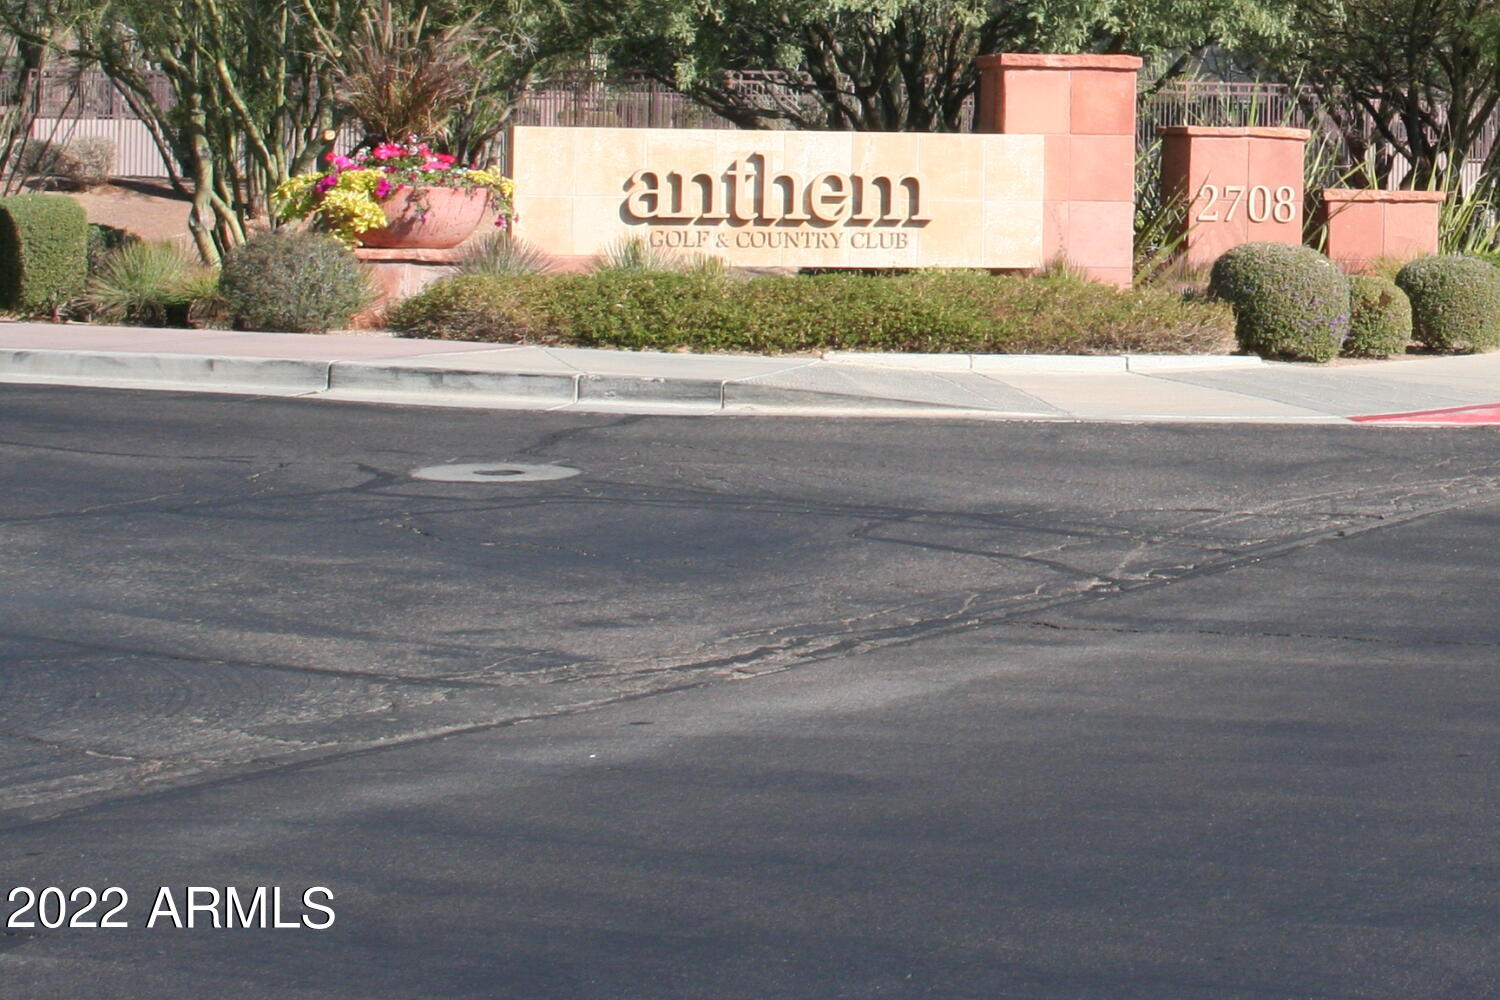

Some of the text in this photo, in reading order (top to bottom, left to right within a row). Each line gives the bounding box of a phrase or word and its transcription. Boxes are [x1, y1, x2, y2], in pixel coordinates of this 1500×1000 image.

[620, 152, 932, 228] anthem
[1197, 184, 1297, 223] 2708
[649, 230, 908, 249] GOLF & COUNTRY CLUB
